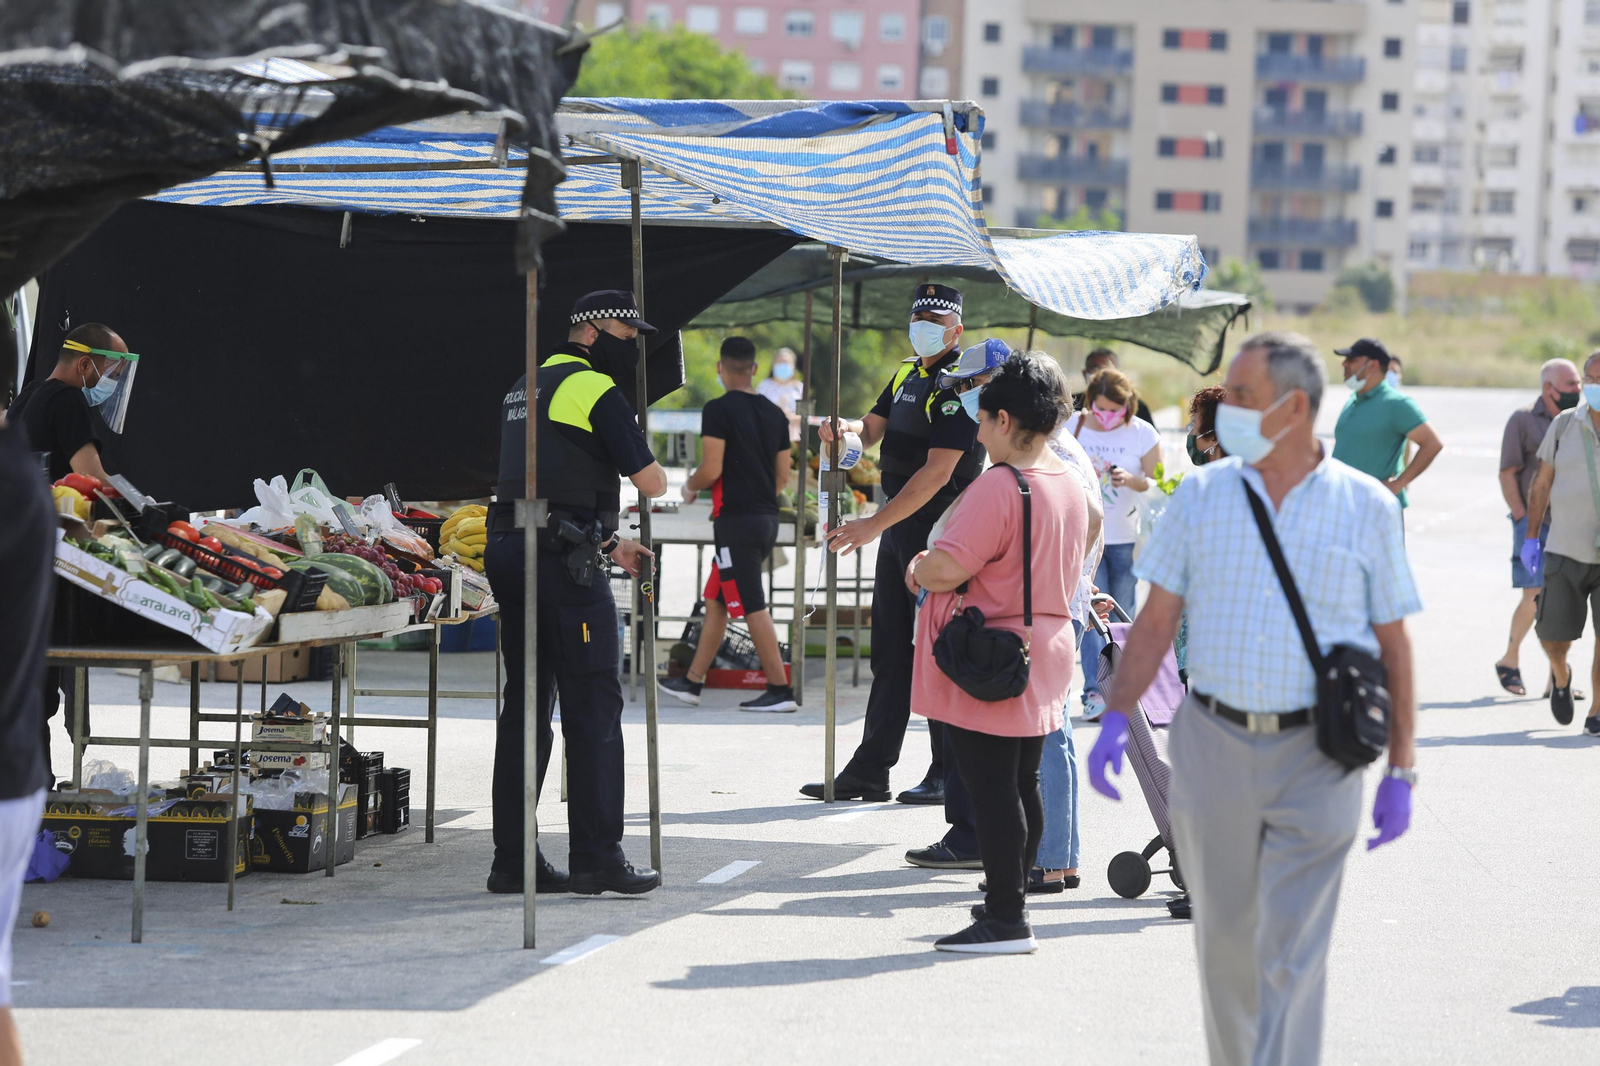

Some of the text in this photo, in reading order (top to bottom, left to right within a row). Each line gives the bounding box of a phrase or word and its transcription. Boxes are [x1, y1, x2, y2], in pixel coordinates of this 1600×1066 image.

[902, 394, 917, 403] POLICÍA
[54, 558, 79, 575] mium
[257, 726, 285, 735] Josema
[257, 754, 292, 763] Josema
